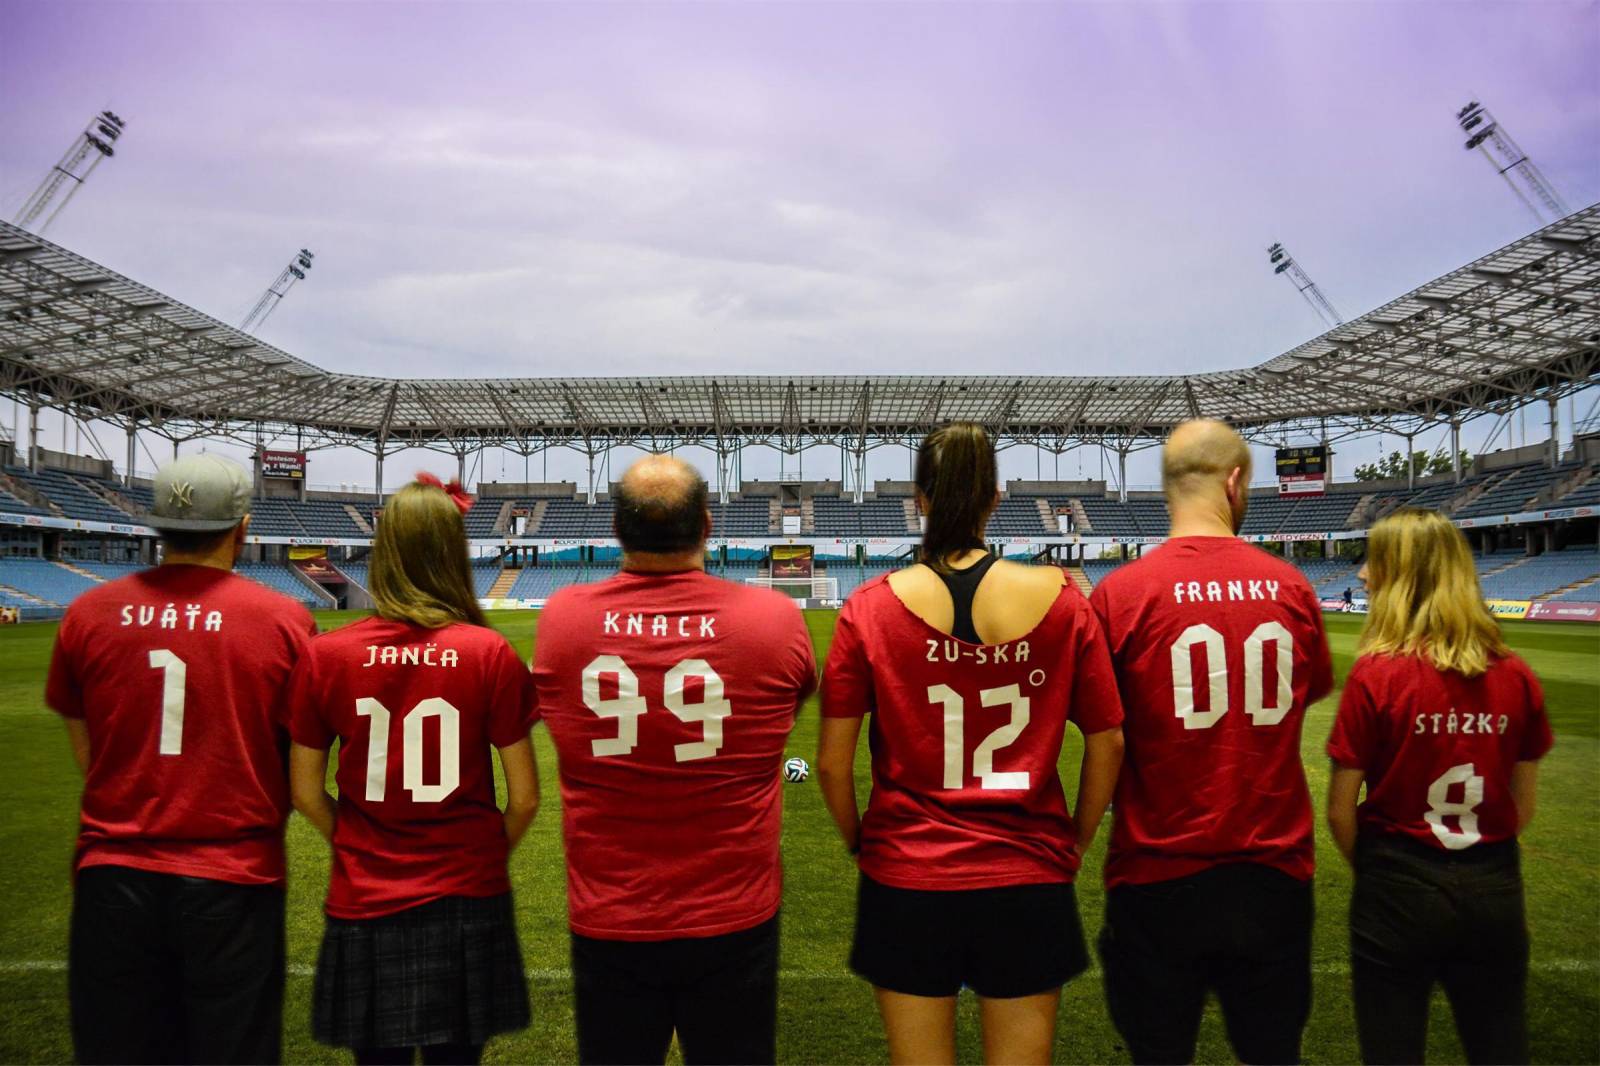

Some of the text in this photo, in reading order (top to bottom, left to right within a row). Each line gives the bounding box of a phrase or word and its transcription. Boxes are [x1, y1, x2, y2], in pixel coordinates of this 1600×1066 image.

[1271, 533, 1326, 541] MEDYCZNY
[1173, 578, 1280, 604] FRANKY
[603, 611, 717, 638] KNACK
[925, 638, 1031, 665] ZU-SKA
[362, 642, 459, 668] JANČA
[1170, 621, 1294, 730] 00
[148, 648, 187, 756] 1
[581, 654, 733, 764] 99
[354, 696, 460, 803] 10
[1423, 762, 1485, 851] 8
